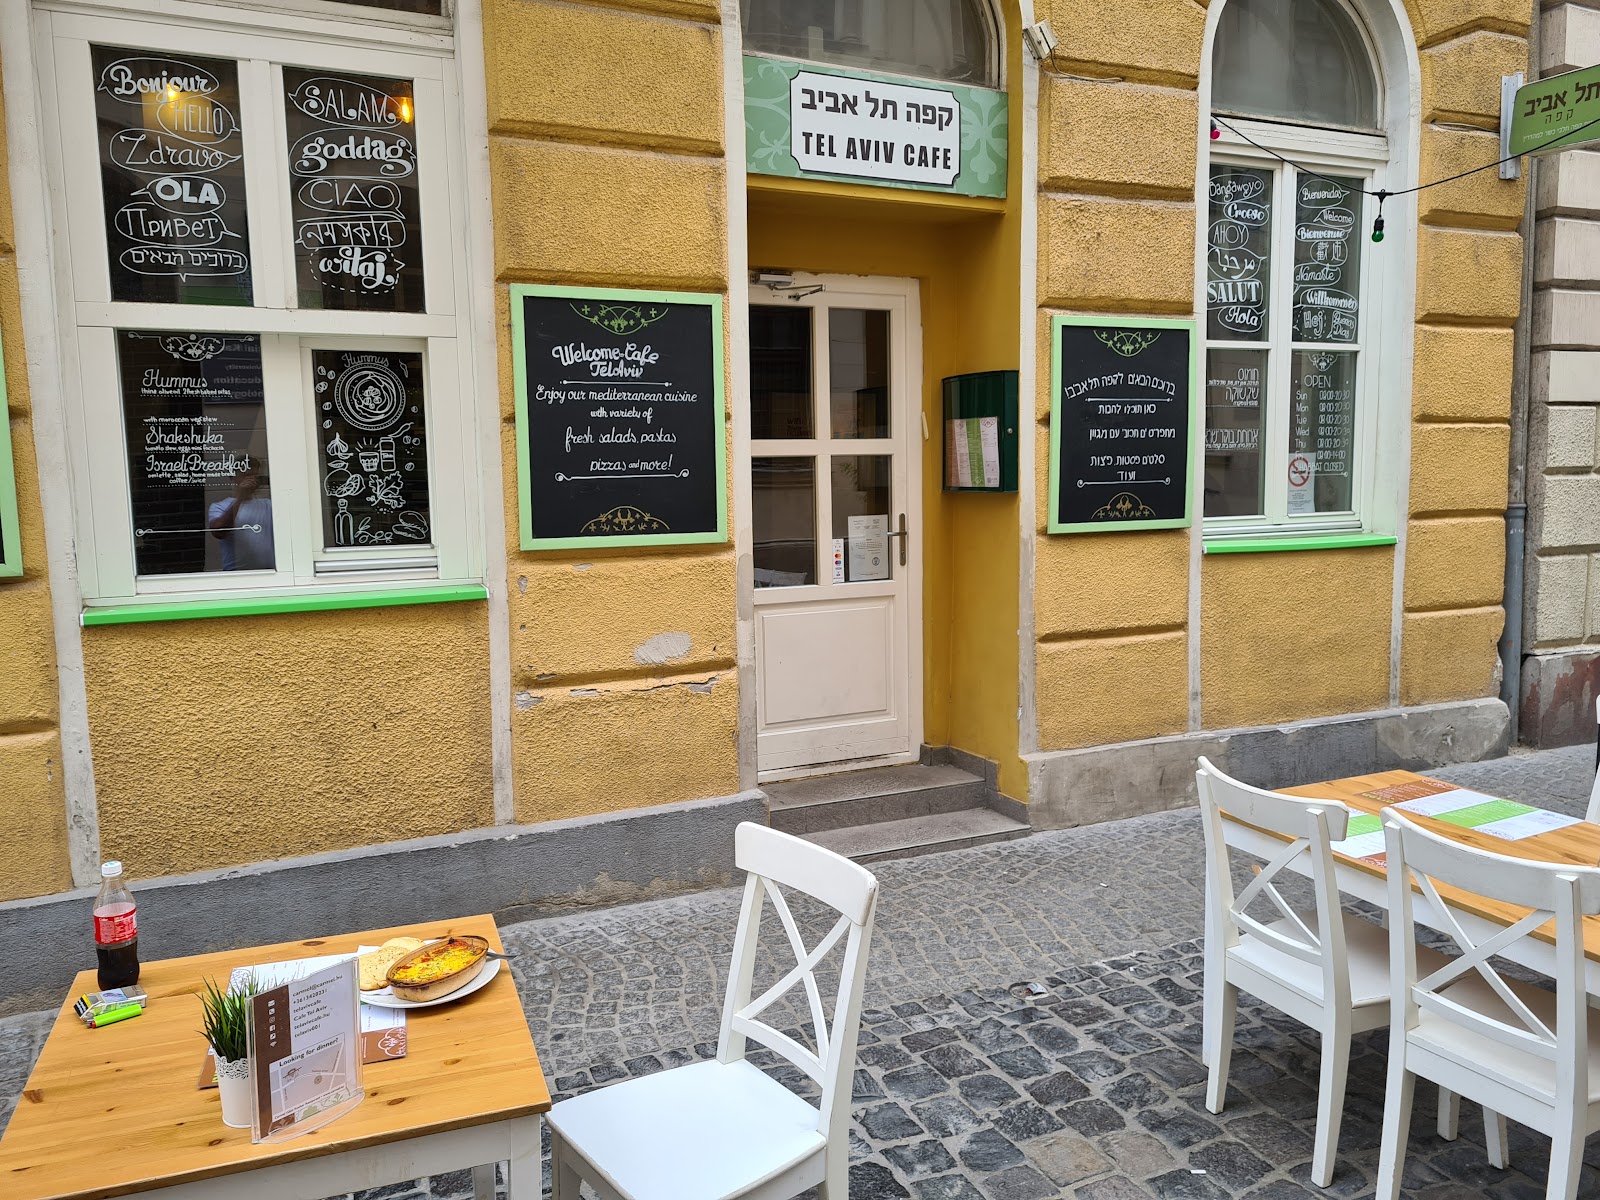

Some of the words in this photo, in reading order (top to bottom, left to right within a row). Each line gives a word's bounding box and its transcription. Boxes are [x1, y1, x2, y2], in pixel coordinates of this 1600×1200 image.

[110, 65, 212, 103] Bonjour
[1574, 81, 1600, 104] תל
[303, 86, 397, 124] SALAM
[801, 88, 858, 116] אביב
[864, 90, 898, 121] תל
[1524, 90, 1568, 118] אביב
[174, 101, 223, 135] HELLO
[906, 102, 953, 131] קפה
[1544, 108, 1574, 125] קפה
[119, 134, 224, 167] Zdravo
[295, 136, 413, 176] goddag
[802, 131, 837, 158] TEL
[846, 136, 895, 164] AVIV
[903, 143, 951, 170] CAFE
[155, 177, 220, 205] OLA
[1227, 202, 1265, 221] Croeso
[1322, 210, 1353, 224] Welcome
[1212, 224, 1247, 244] AHOY
[1297, 227, 1346, 240] Bienvenue
[130, 249, 184, 267] הבאים
[188, 250, 245, 269] ברוכים
[1215, 248, 1255, 280] مرحبا
[1295, 263, 1335, 281] Namaste
[1207, 281, 1260, 303] SALUT
[1306, 289, 1358, 311] Willkommen
[1225, 305, 1258, 327] Hola
[1303, 310, 1324, 336] Hej
[341, 352, 389, 368] Hummus
[551, 342, 620, 366] Welcome
[624, 342, 660, 366] Cafe
[142, 369, 208, 388] Hummus
[1304, 374, 1332, 388] OPEN
[536, 384, 566, 404] Enjoy
[568, 389, 586, 401] our
[589, 388, 663, 402] mediterranean
[664, 391, 698, 403] cuisine
[1296, 390, 1308, 400] Sun
[590, 408, 609, 418] with
[609, 407, 641, 419] variety
[642, 407, 653, 424] of
[1296, 402, 1309, 412] Mon
[1295, 414, 1308, 424] Tue
[146, 426, 225, 444] Shakshuka
[565, 426, 595, 453] fresh
[640, 428, 677, 444] pastas
[1295, 426, 1310, 436] Wed
[1295, 438, 1307, 448] Thu
[146, 454, 188, 472] Israeli
[188, 454, 251, 473] Breakfast
[590, 459, 627, 471] pizzas
[628, 459, 640, 468] and
[640, 454, 673, 471] more!
[1323, 461, 1345, 472] CLOSED
[315, 1005, 328, 1013] Aviv
[279, 1053, 305, 1067] Looking
[306, 1048, 317, 1057] for
